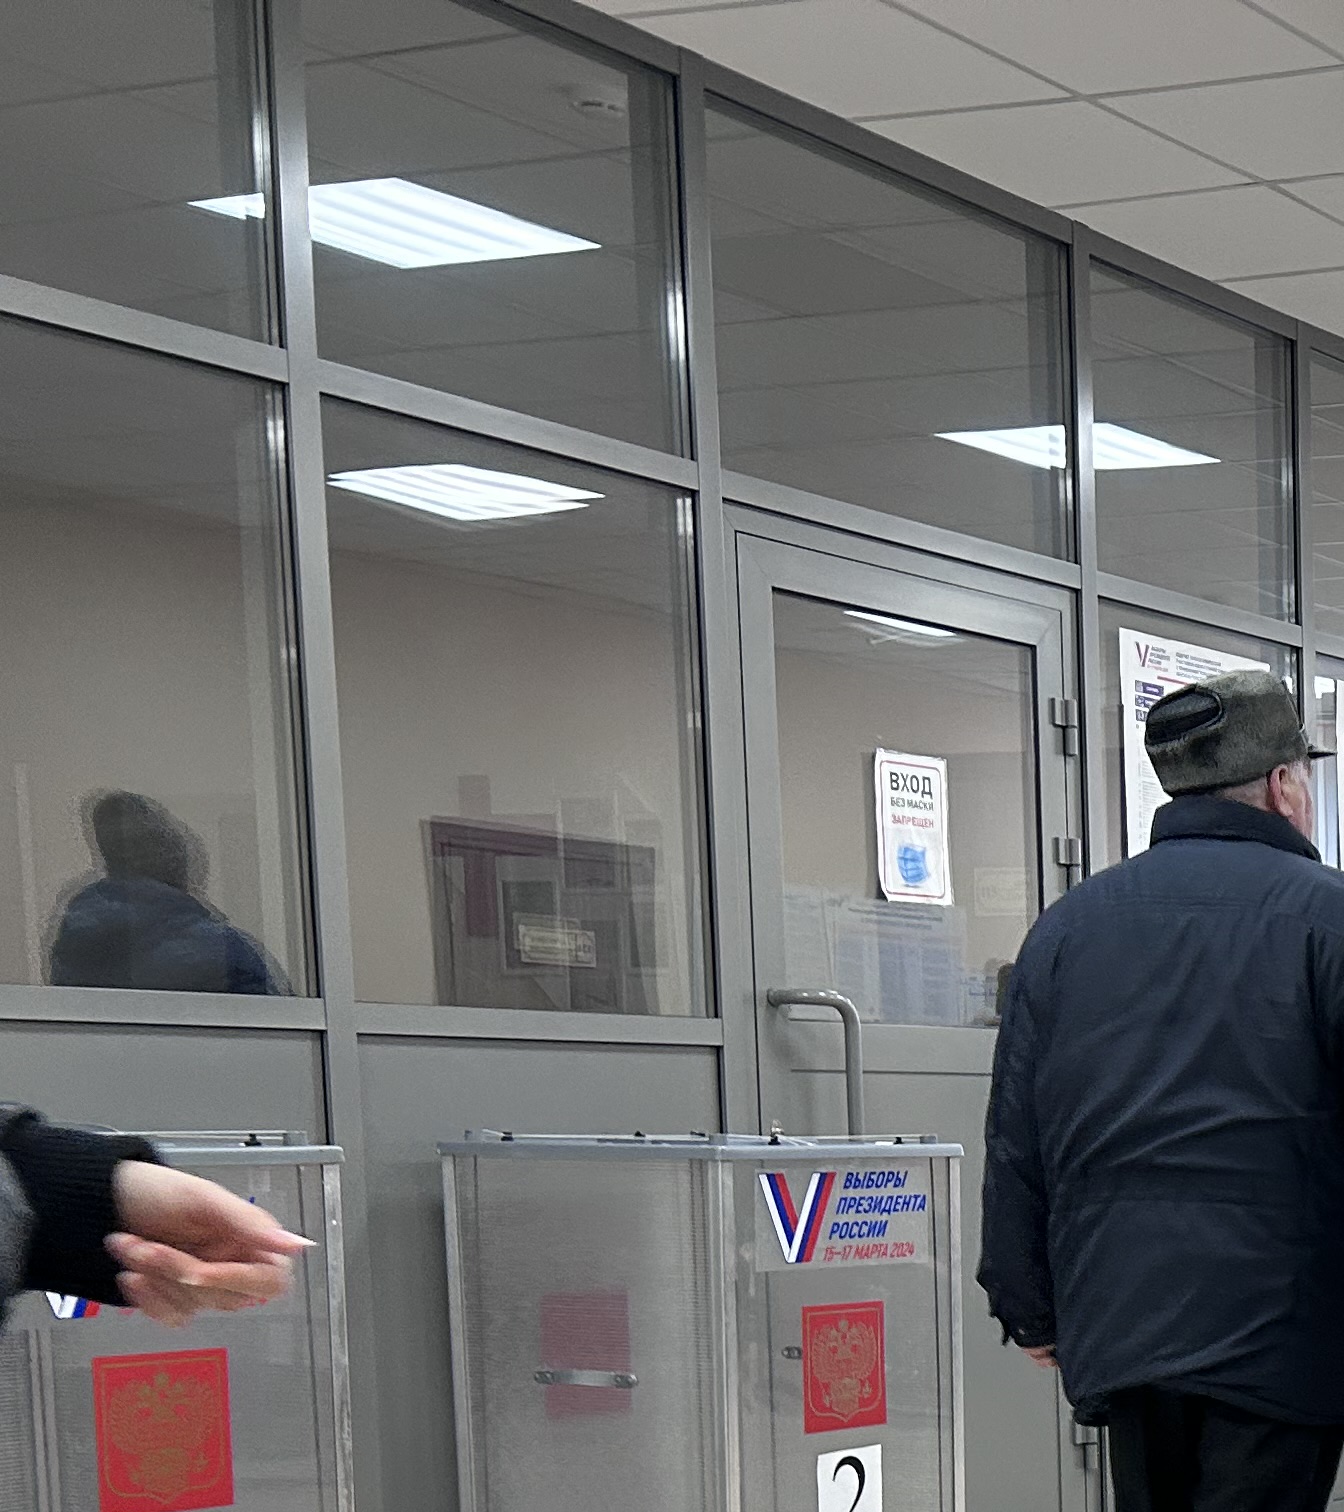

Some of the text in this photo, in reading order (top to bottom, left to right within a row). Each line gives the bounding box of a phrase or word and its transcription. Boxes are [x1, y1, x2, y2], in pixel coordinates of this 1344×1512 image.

[889, 771, 933, 799] ВХОД
[890, 796, 934, 811] БЕЗ МАСКИ
[891, 814, 934, 829] ЗАПРЕЩЕН
[843, 1171, 908, 1189] ВЫБОРЫ
[836, 1194, 927, 1216] ПРЕЗИДЕНТА
[828, 1220, 888, 1240] РОССИИ
[853, 1243, 888, 1260] МАРТА
[890, 1241, 915, 1257] 2024
